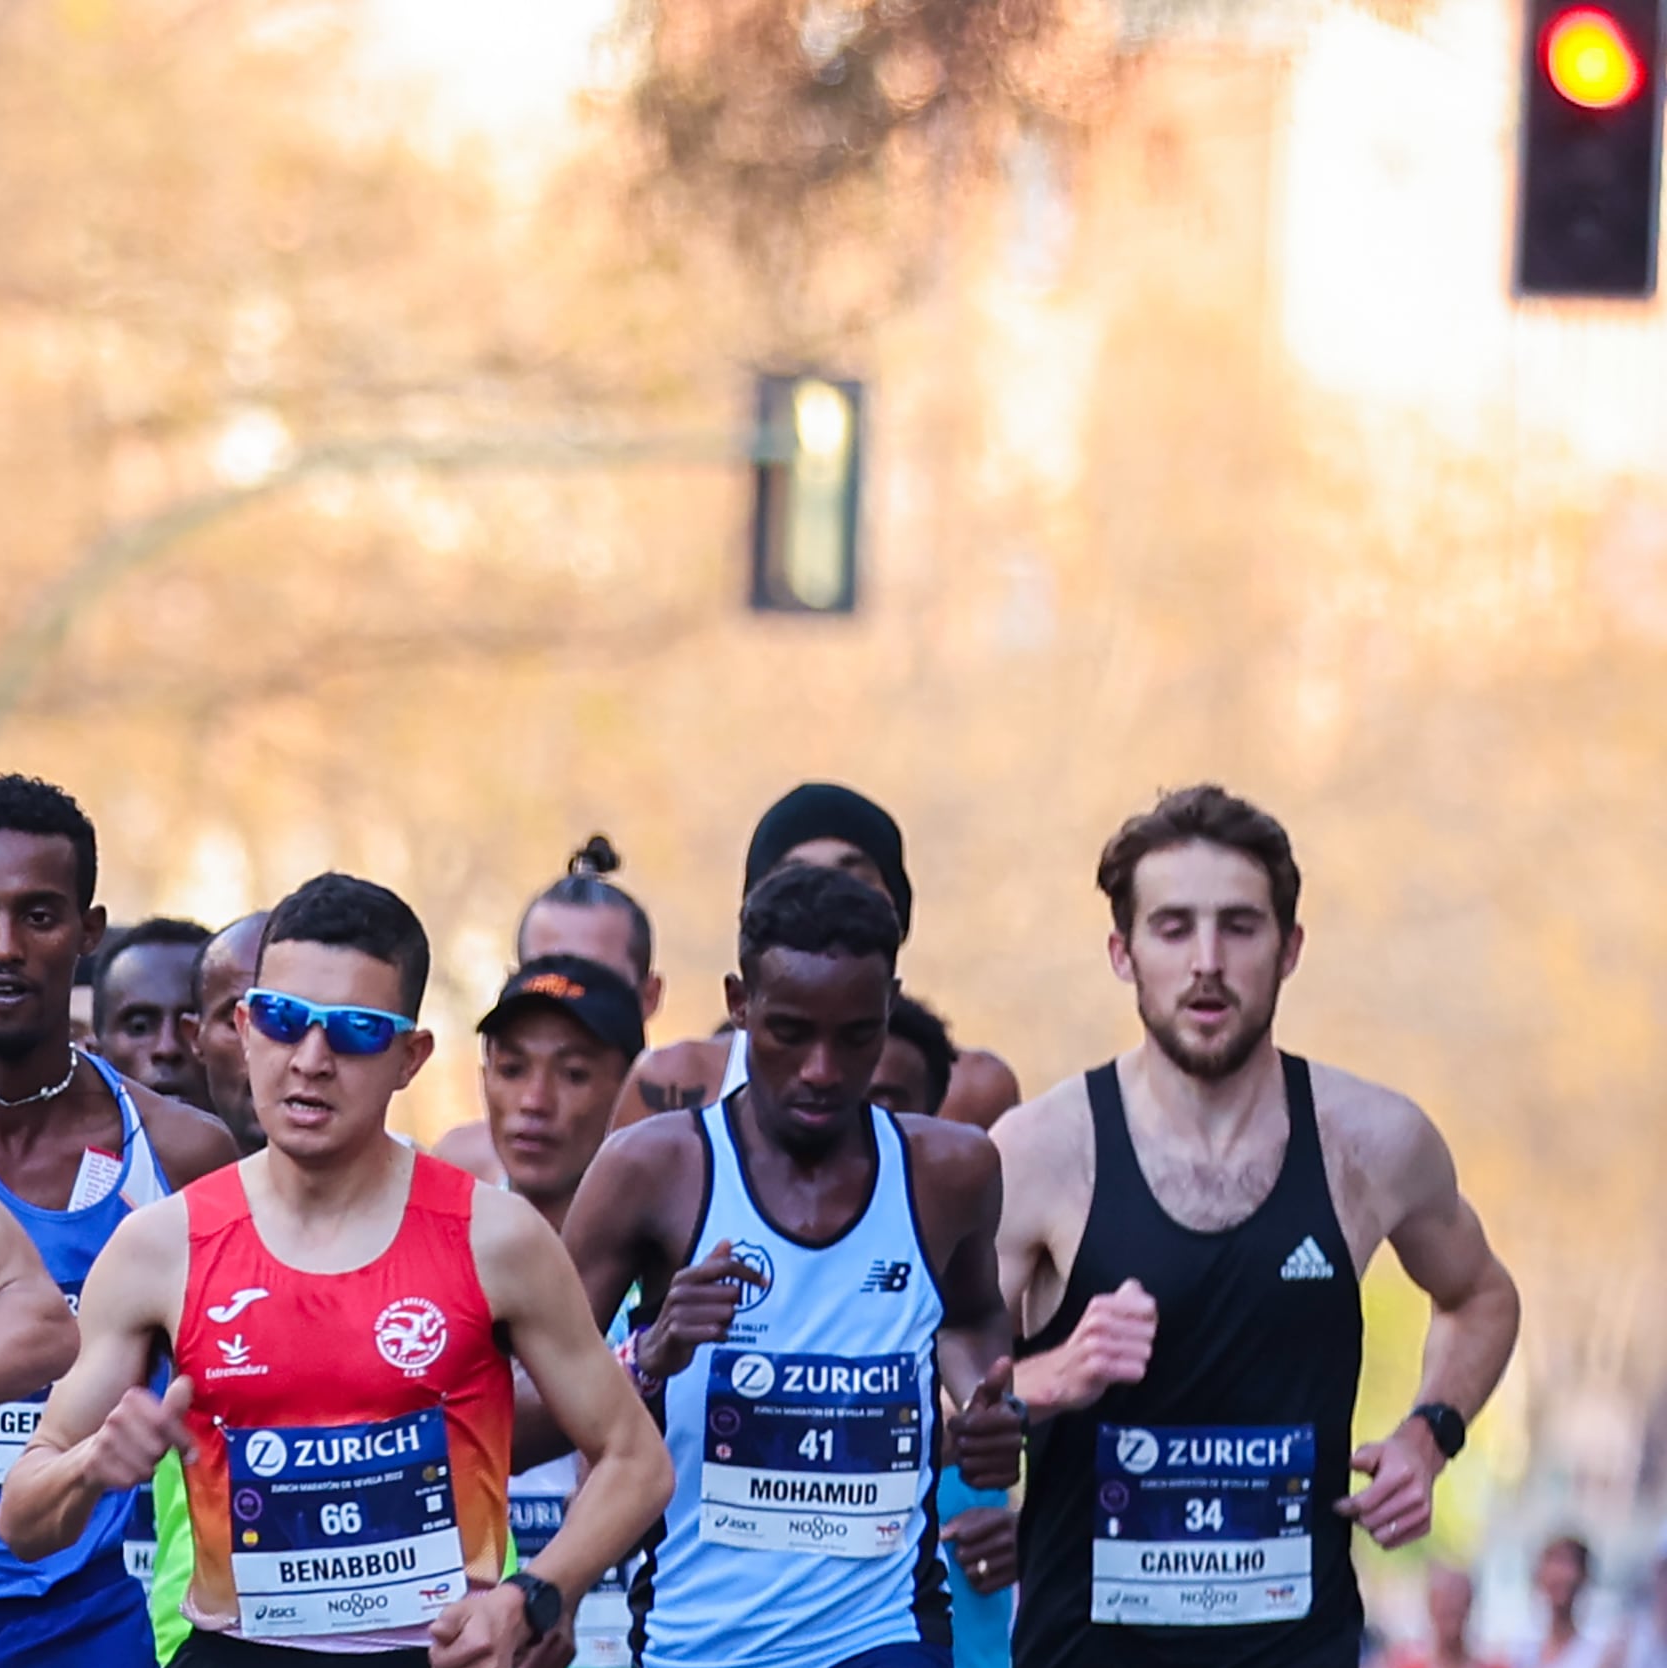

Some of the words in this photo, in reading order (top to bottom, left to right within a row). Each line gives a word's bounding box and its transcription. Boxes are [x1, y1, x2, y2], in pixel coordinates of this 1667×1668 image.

[205, 1363, 269, 1379] Extremadura
[782, 1365, 899, 1394] ZURICH
[294, 1424, 420, 1467] ZURICH
[798, 1429, 834, 1462] 41
[1167, 1437, 1291, 1467] ZURICH
[749, 1478, 878, 1505] MOHAMUD
[320, 1502, 362, 1535] 66
[1185, 1498, 1224, 1532] 34
[279, 1548, 416, 1583] BENABBOU
[1141, 1549, 1265, 1573] CARVALHO
